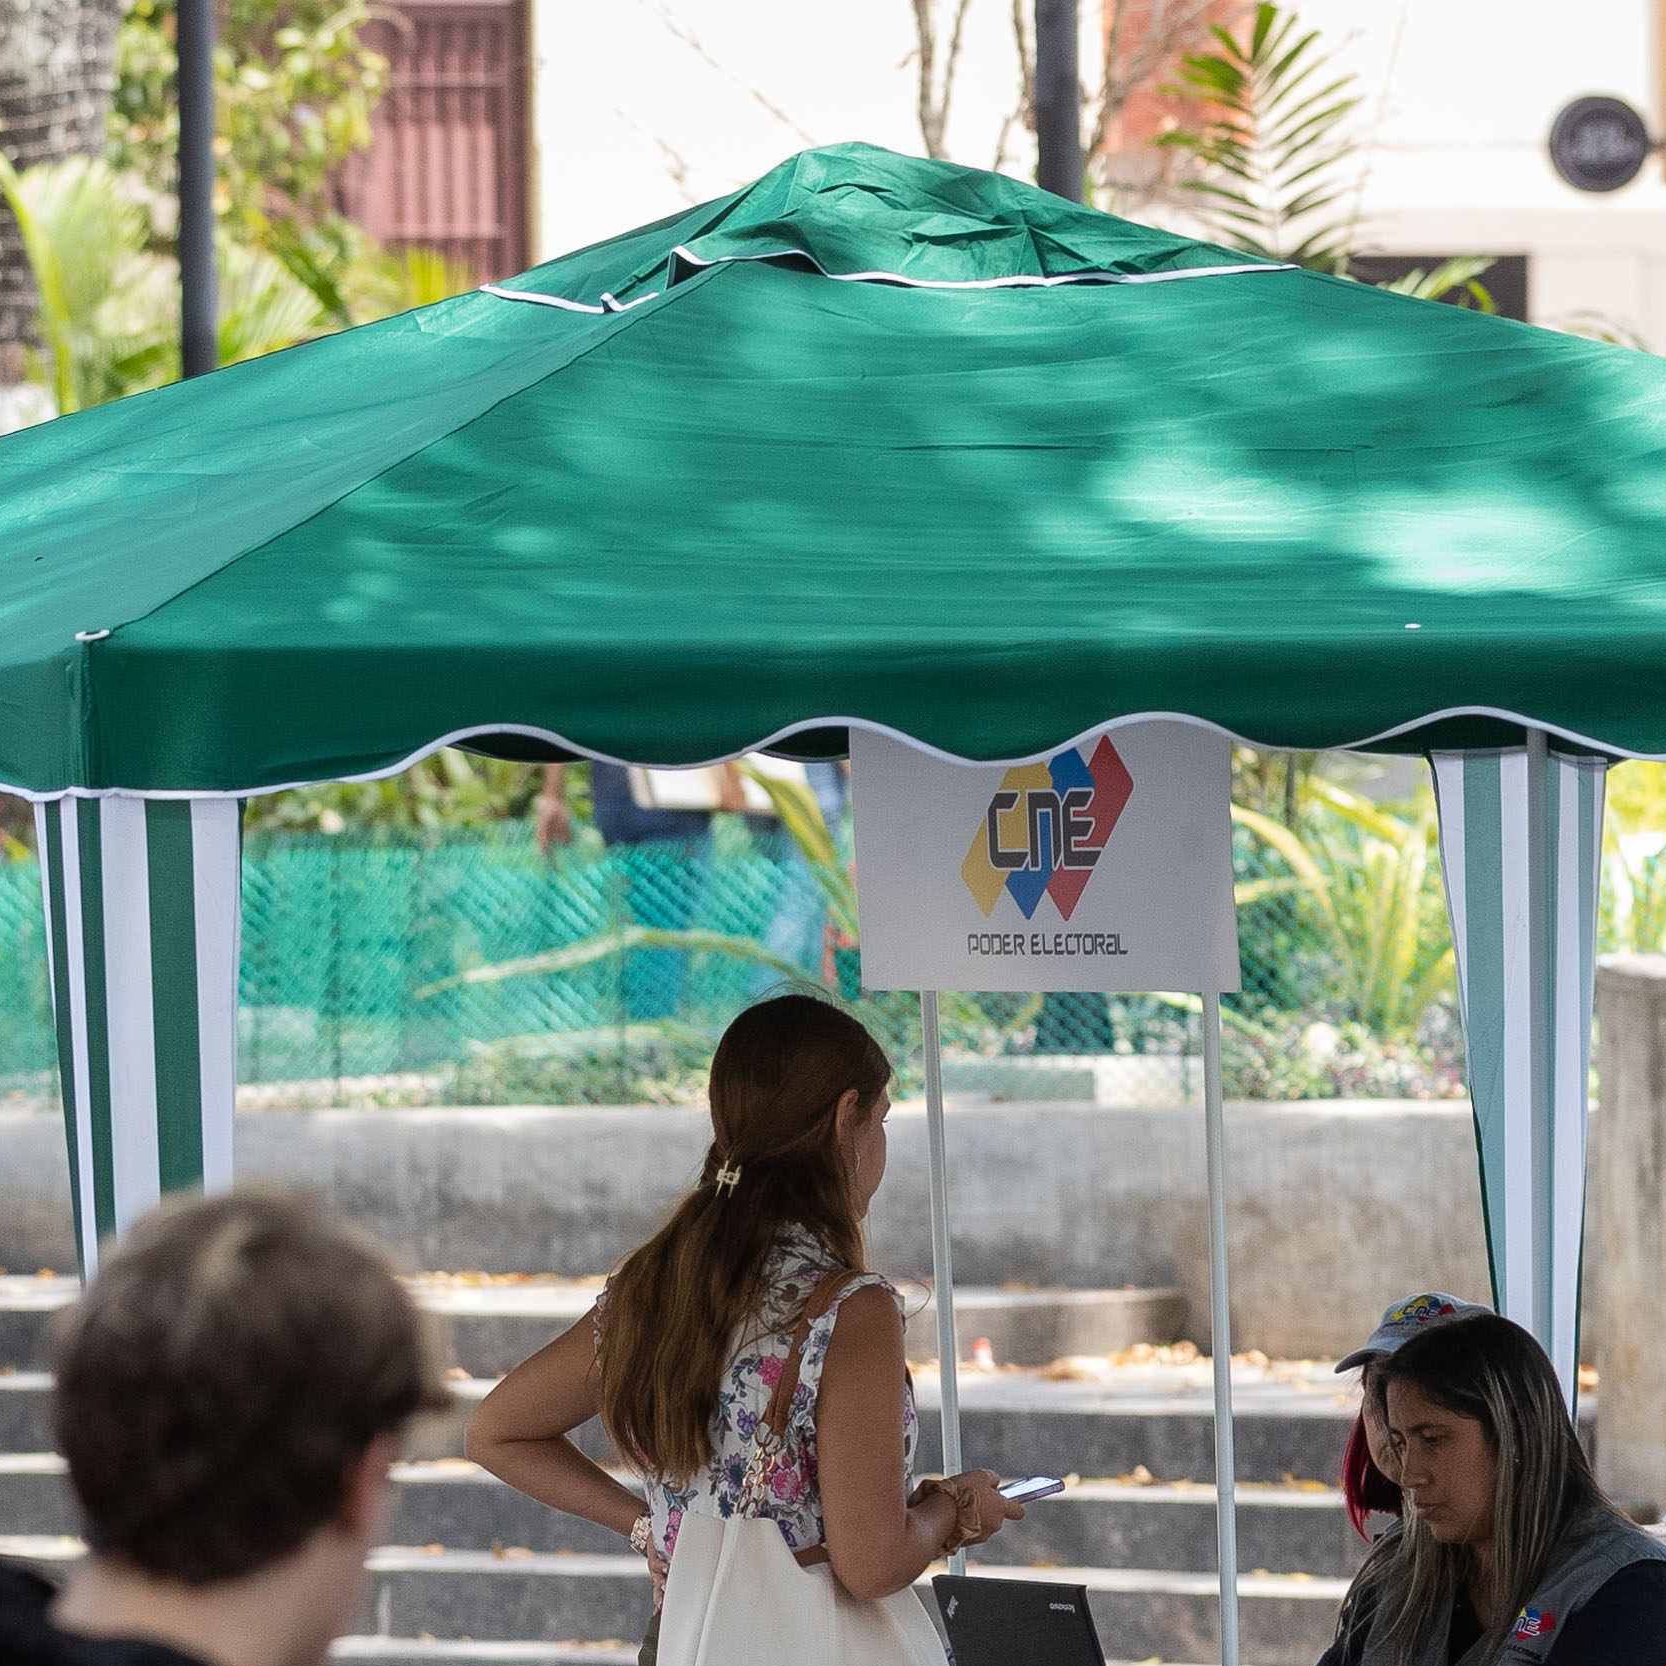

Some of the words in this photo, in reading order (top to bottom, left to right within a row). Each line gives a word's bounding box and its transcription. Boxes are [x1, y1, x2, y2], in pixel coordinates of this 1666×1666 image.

[987, 790, 1104, 871] CNE
[967, 932, 1027, 956] PODER
[1030, 932, 1130, 956] ELECTORAL
[1402, 1303, 1439, 1319] CNE
[1513, 1615, 1541, 1637] NE
